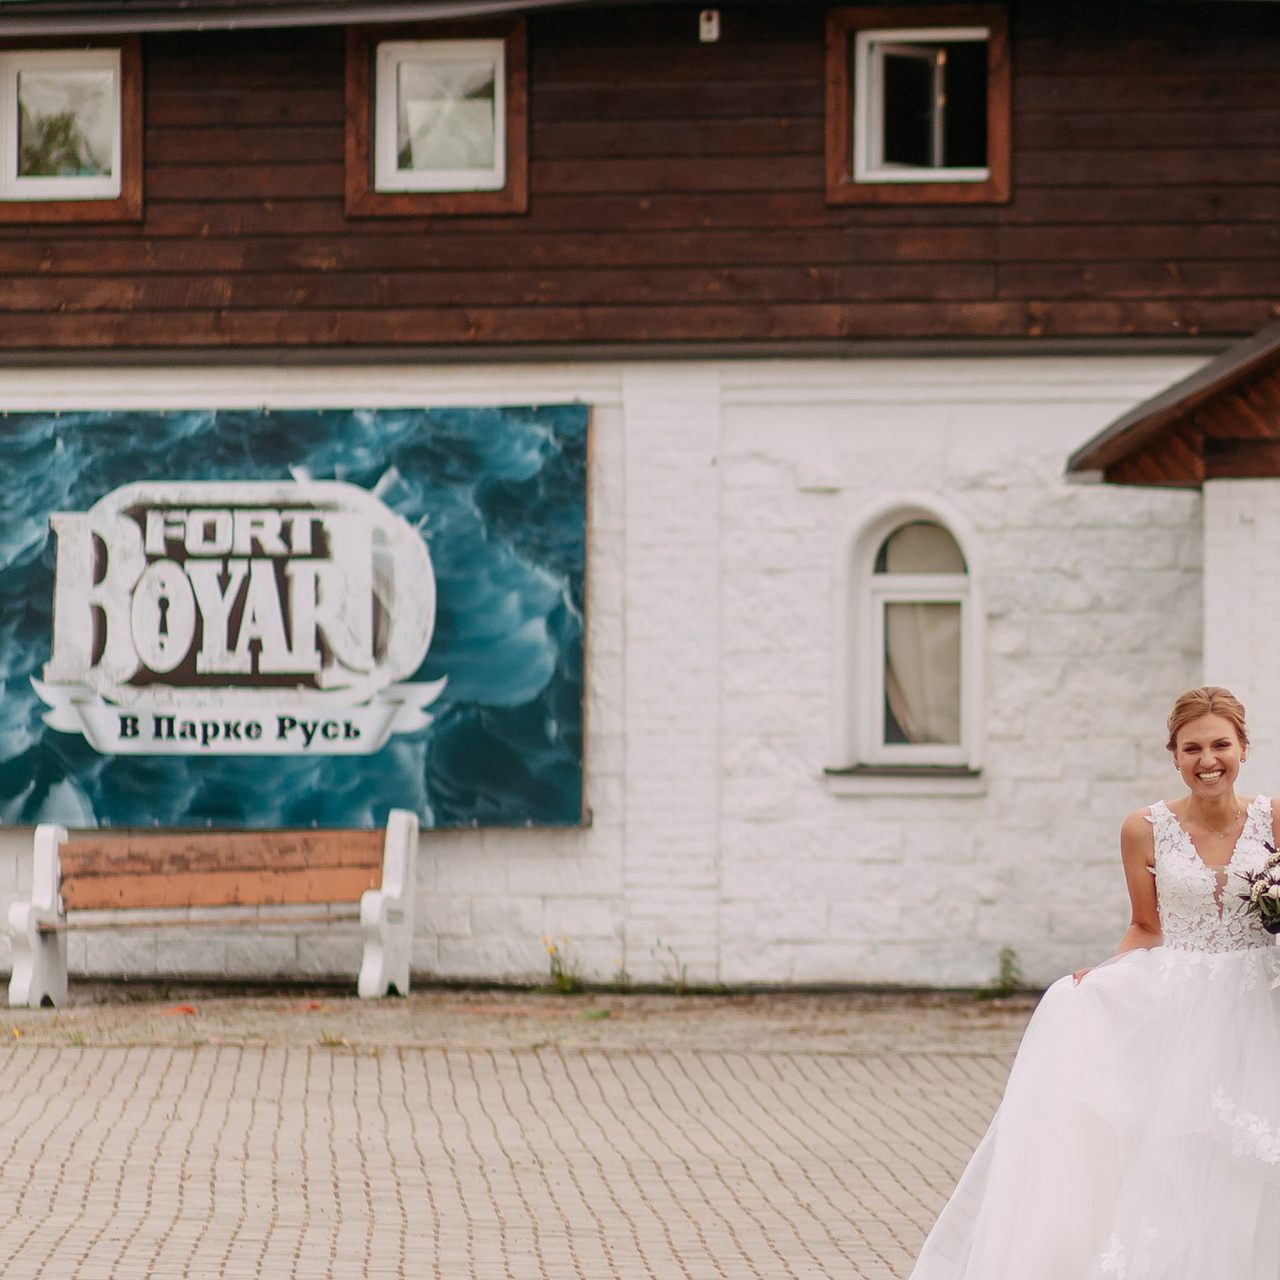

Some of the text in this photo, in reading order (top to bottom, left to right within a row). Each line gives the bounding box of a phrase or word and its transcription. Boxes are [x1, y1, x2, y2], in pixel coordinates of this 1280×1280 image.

[145, 510, 324, 556] FORT
[43, 505, 436, 692] BOYARD
[119, 715, 362, 749] В Парке Русь
